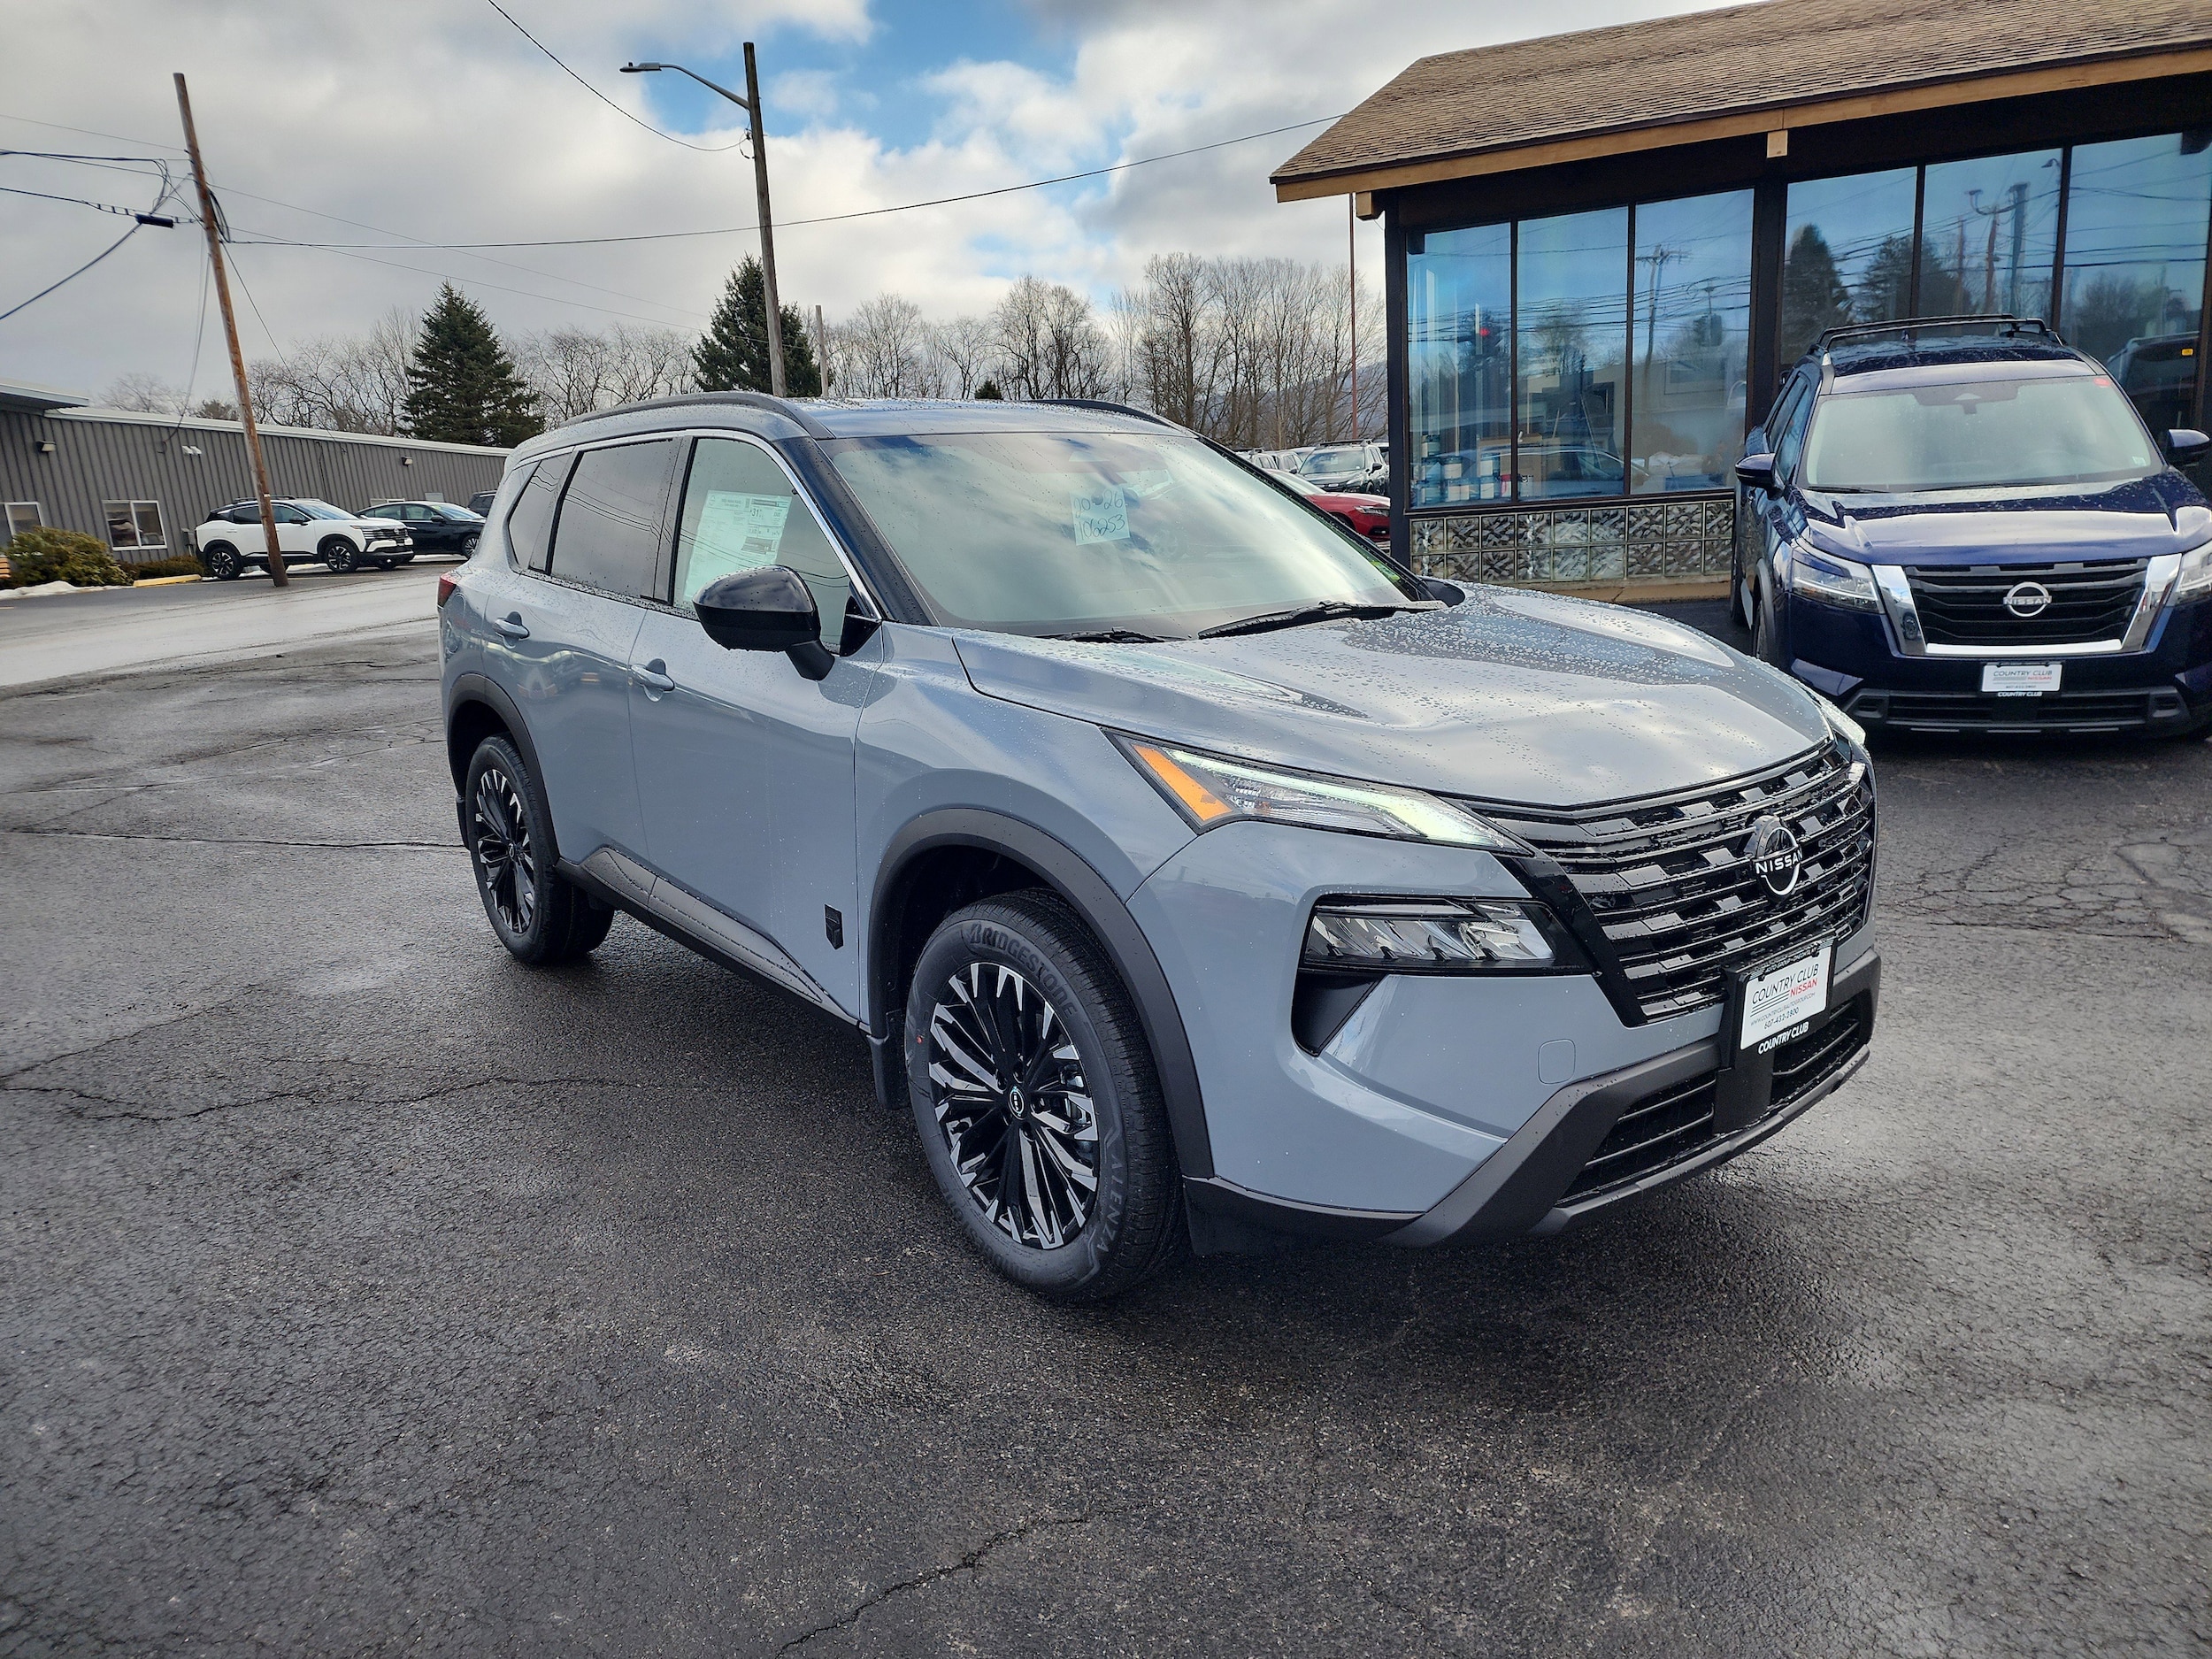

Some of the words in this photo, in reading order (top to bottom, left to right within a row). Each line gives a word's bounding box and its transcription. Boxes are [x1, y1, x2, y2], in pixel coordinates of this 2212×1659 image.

[1079, 514, 1125, 541] 106253
[1755, 847, 1803, 874] NISSAN
[969, 922, 1078, 1018] BRIDGESTONE
[1752, 973, 1796, 1004] COUNTRY
[1797, 964, 1819, 983] CLUB
[1789, 979, 1818, 997] NISSAN
[1758, 1029, 1793, 1055] COUNTRY
[1790, 1021, 1809, 1039] CLUB
[1098, 1158, 1123, 1253] ALENZA
